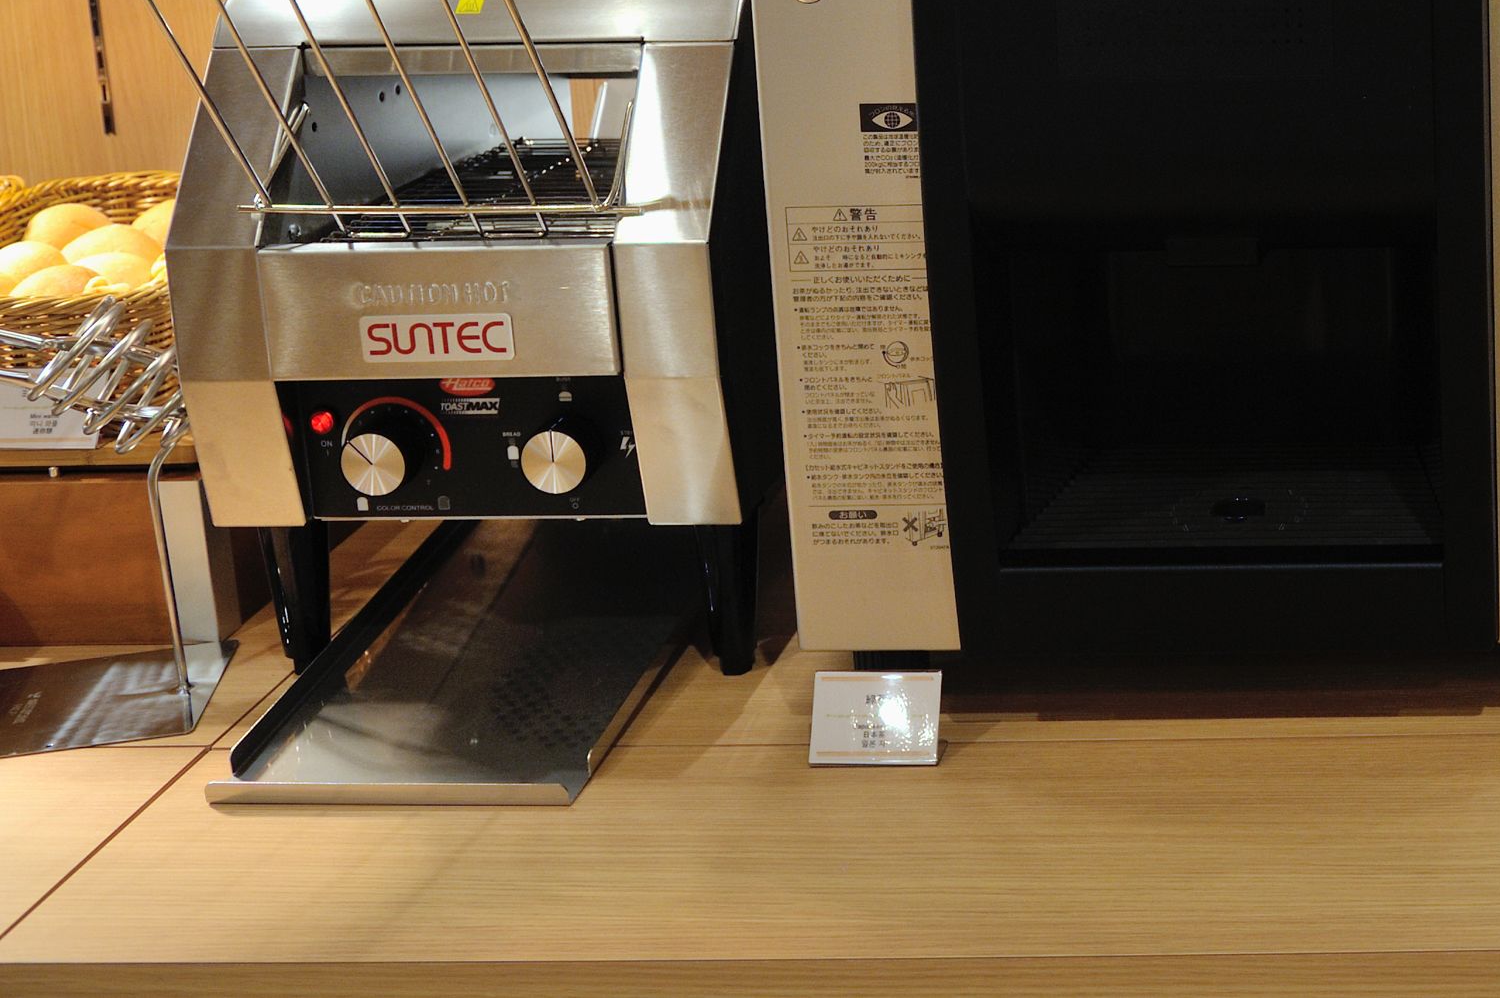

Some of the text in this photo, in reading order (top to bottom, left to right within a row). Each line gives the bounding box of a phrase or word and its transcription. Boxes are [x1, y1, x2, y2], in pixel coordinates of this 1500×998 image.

[850, 208, 877, 221] 警告
[813, 276, 911, 284] 正しくお使いいただくために
[464, 281, 510, 304] HOT
[367, 321, 507, 355] SUNTEC
[441, 378, 492, 391] Hatco
[839, 511, 867, 519] お願い
